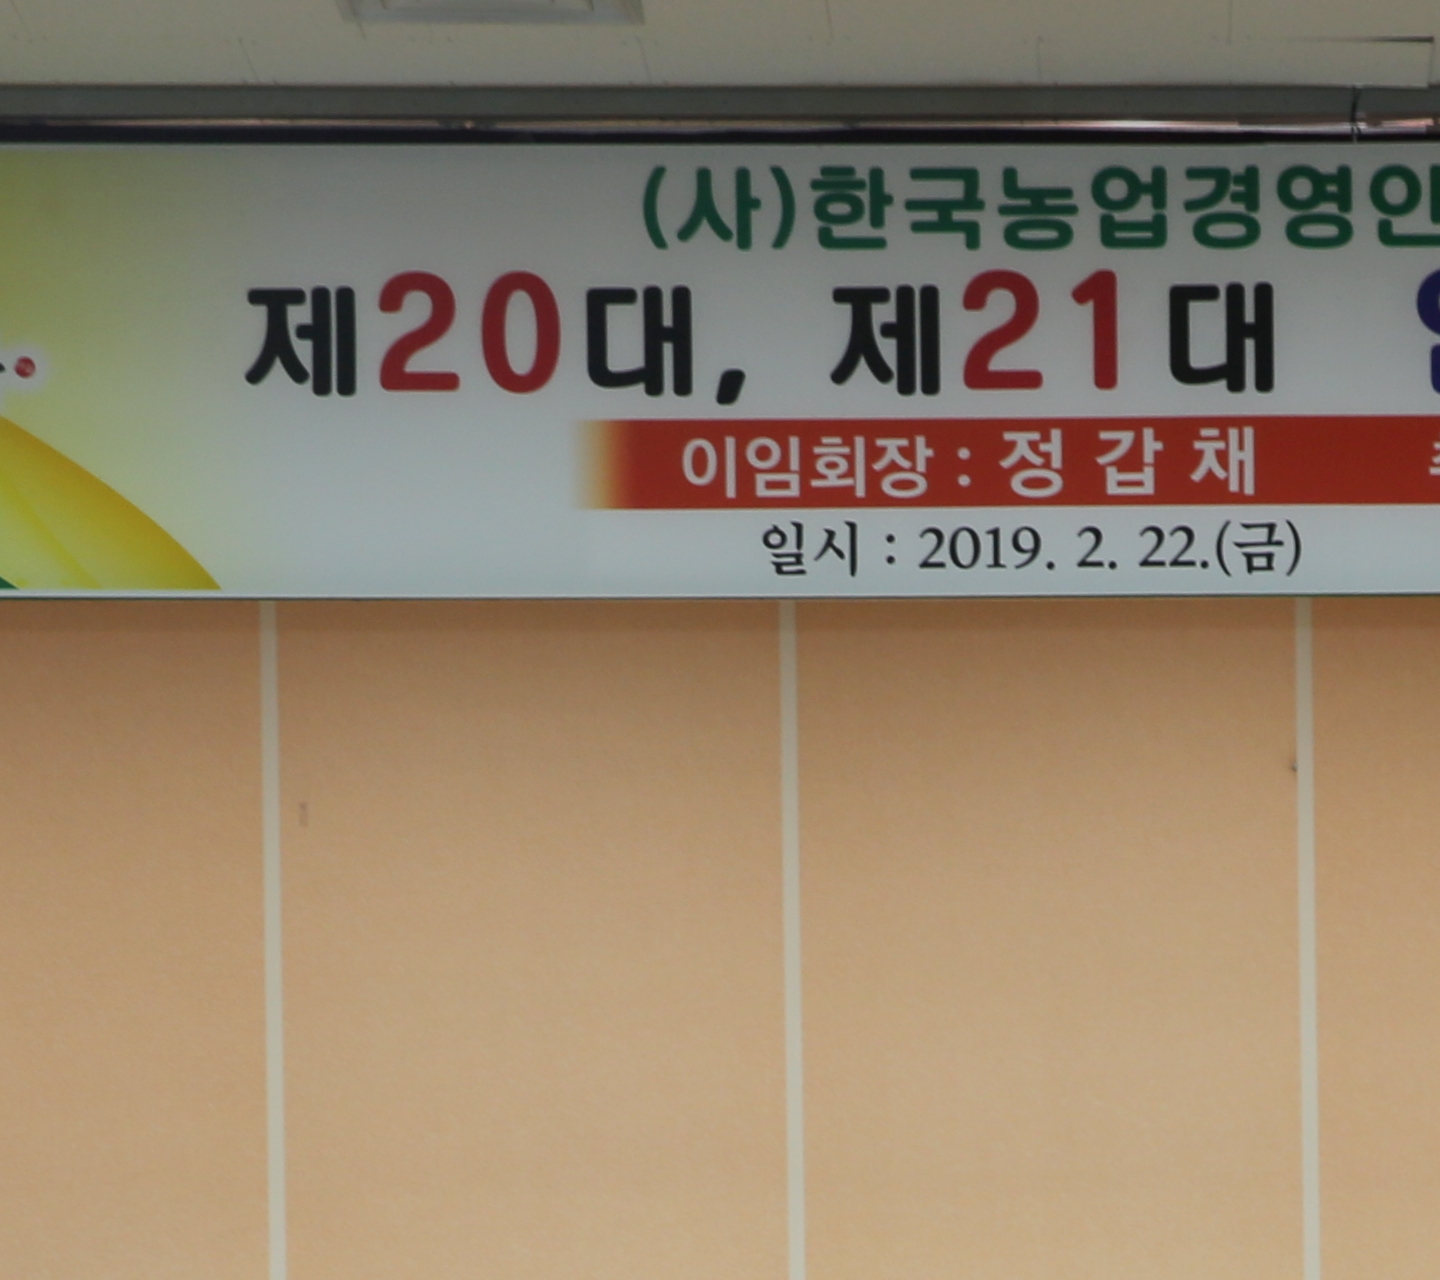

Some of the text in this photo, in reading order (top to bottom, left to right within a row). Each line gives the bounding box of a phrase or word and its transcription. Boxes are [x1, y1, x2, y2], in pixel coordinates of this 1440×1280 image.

[247, 269, 748, 409] 제20대,
[830, 265, 1275, 400] 제21대
[681, 435, 934, 499] 이임회장
[762, 522, 857, 577] 일시
